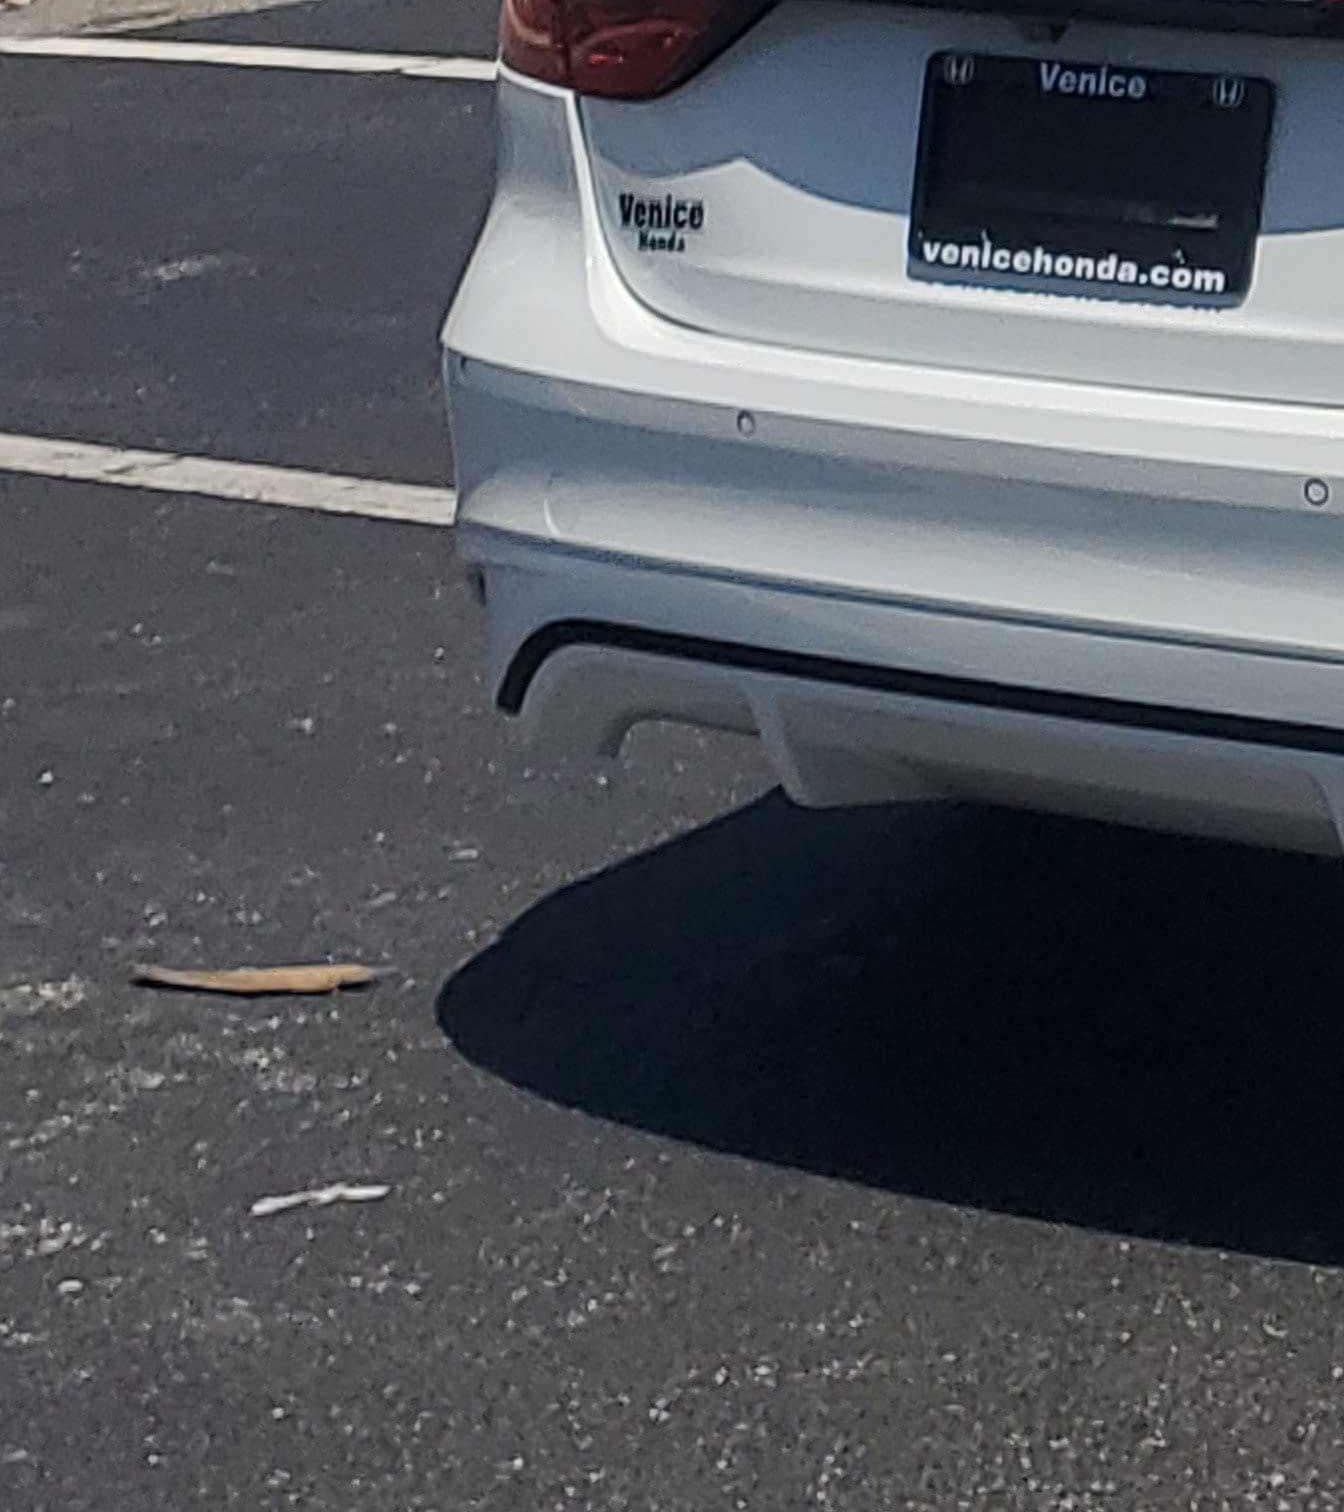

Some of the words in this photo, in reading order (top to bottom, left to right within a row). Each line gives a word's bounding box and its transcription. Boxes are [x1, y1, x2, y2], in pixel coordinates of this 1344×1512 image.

[1039, 61, 1148, 100] Venice
[618, 193, 705, 230] Venice
[922, 239, 1226, 294] venicehonda.com
